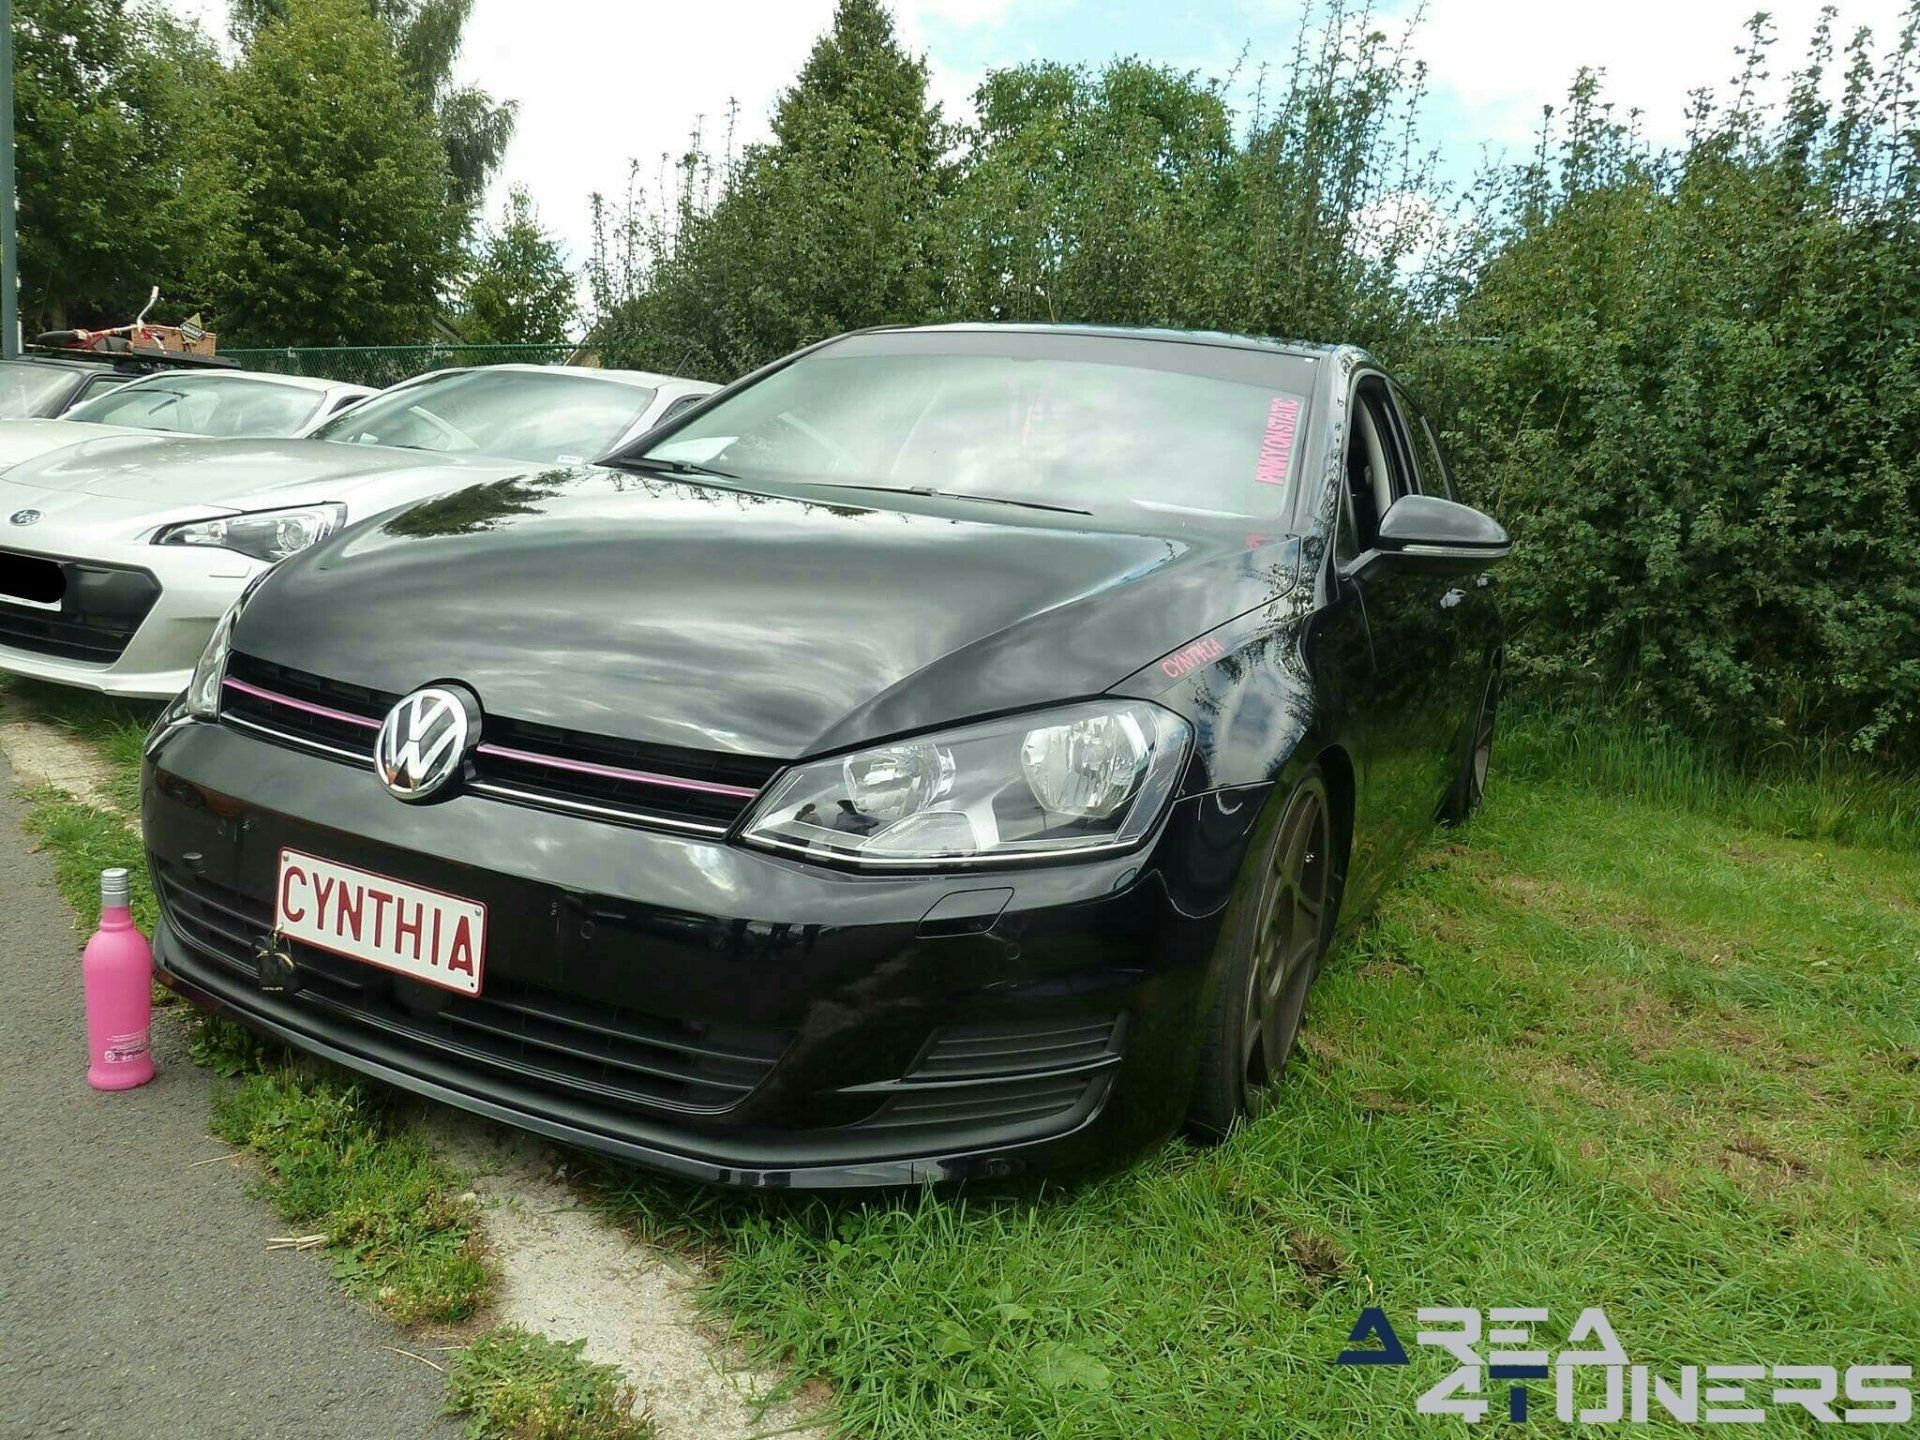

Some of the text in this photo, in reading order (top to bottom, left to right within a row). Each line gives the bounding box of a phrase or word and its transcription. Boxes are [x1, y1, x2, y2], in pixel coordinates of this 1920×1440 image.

[1267, 398, 1299, 432] STATIC
[1255, 447, 1290, 485] PINKY
[282, 865, 474, 977] CYNTHIA
